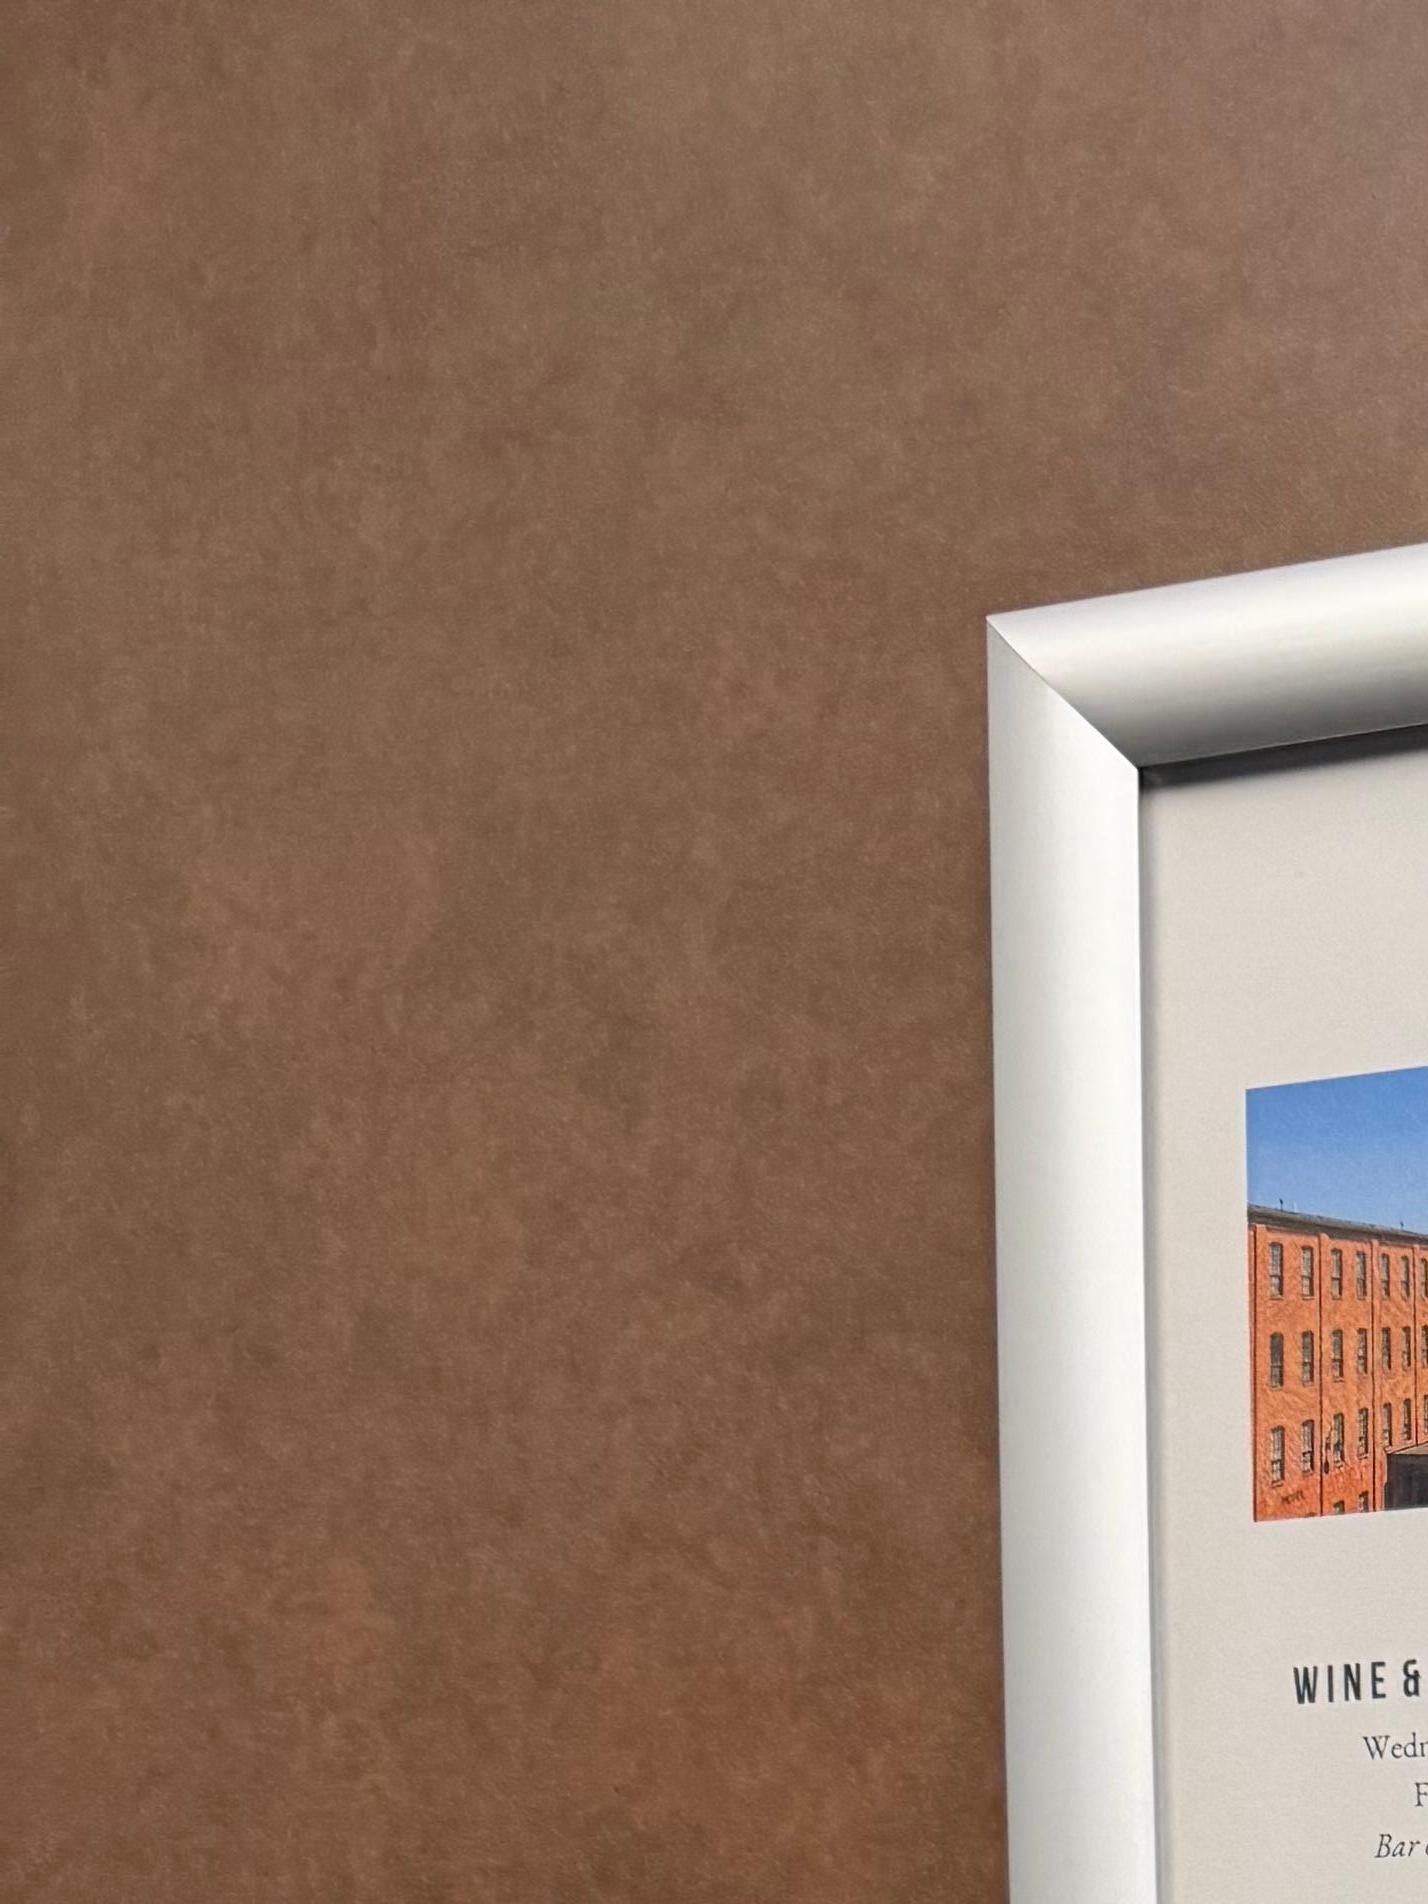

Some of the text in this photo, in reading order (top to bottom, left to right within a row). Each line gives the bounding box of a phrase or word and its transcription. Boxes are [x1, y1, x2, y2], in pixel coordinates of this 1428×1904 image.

[1293, 1661, 1387, 1705] WINE
[1402, 1658, 1421, 1698] &
[1374, 1833, 1421, 1858] Bar
